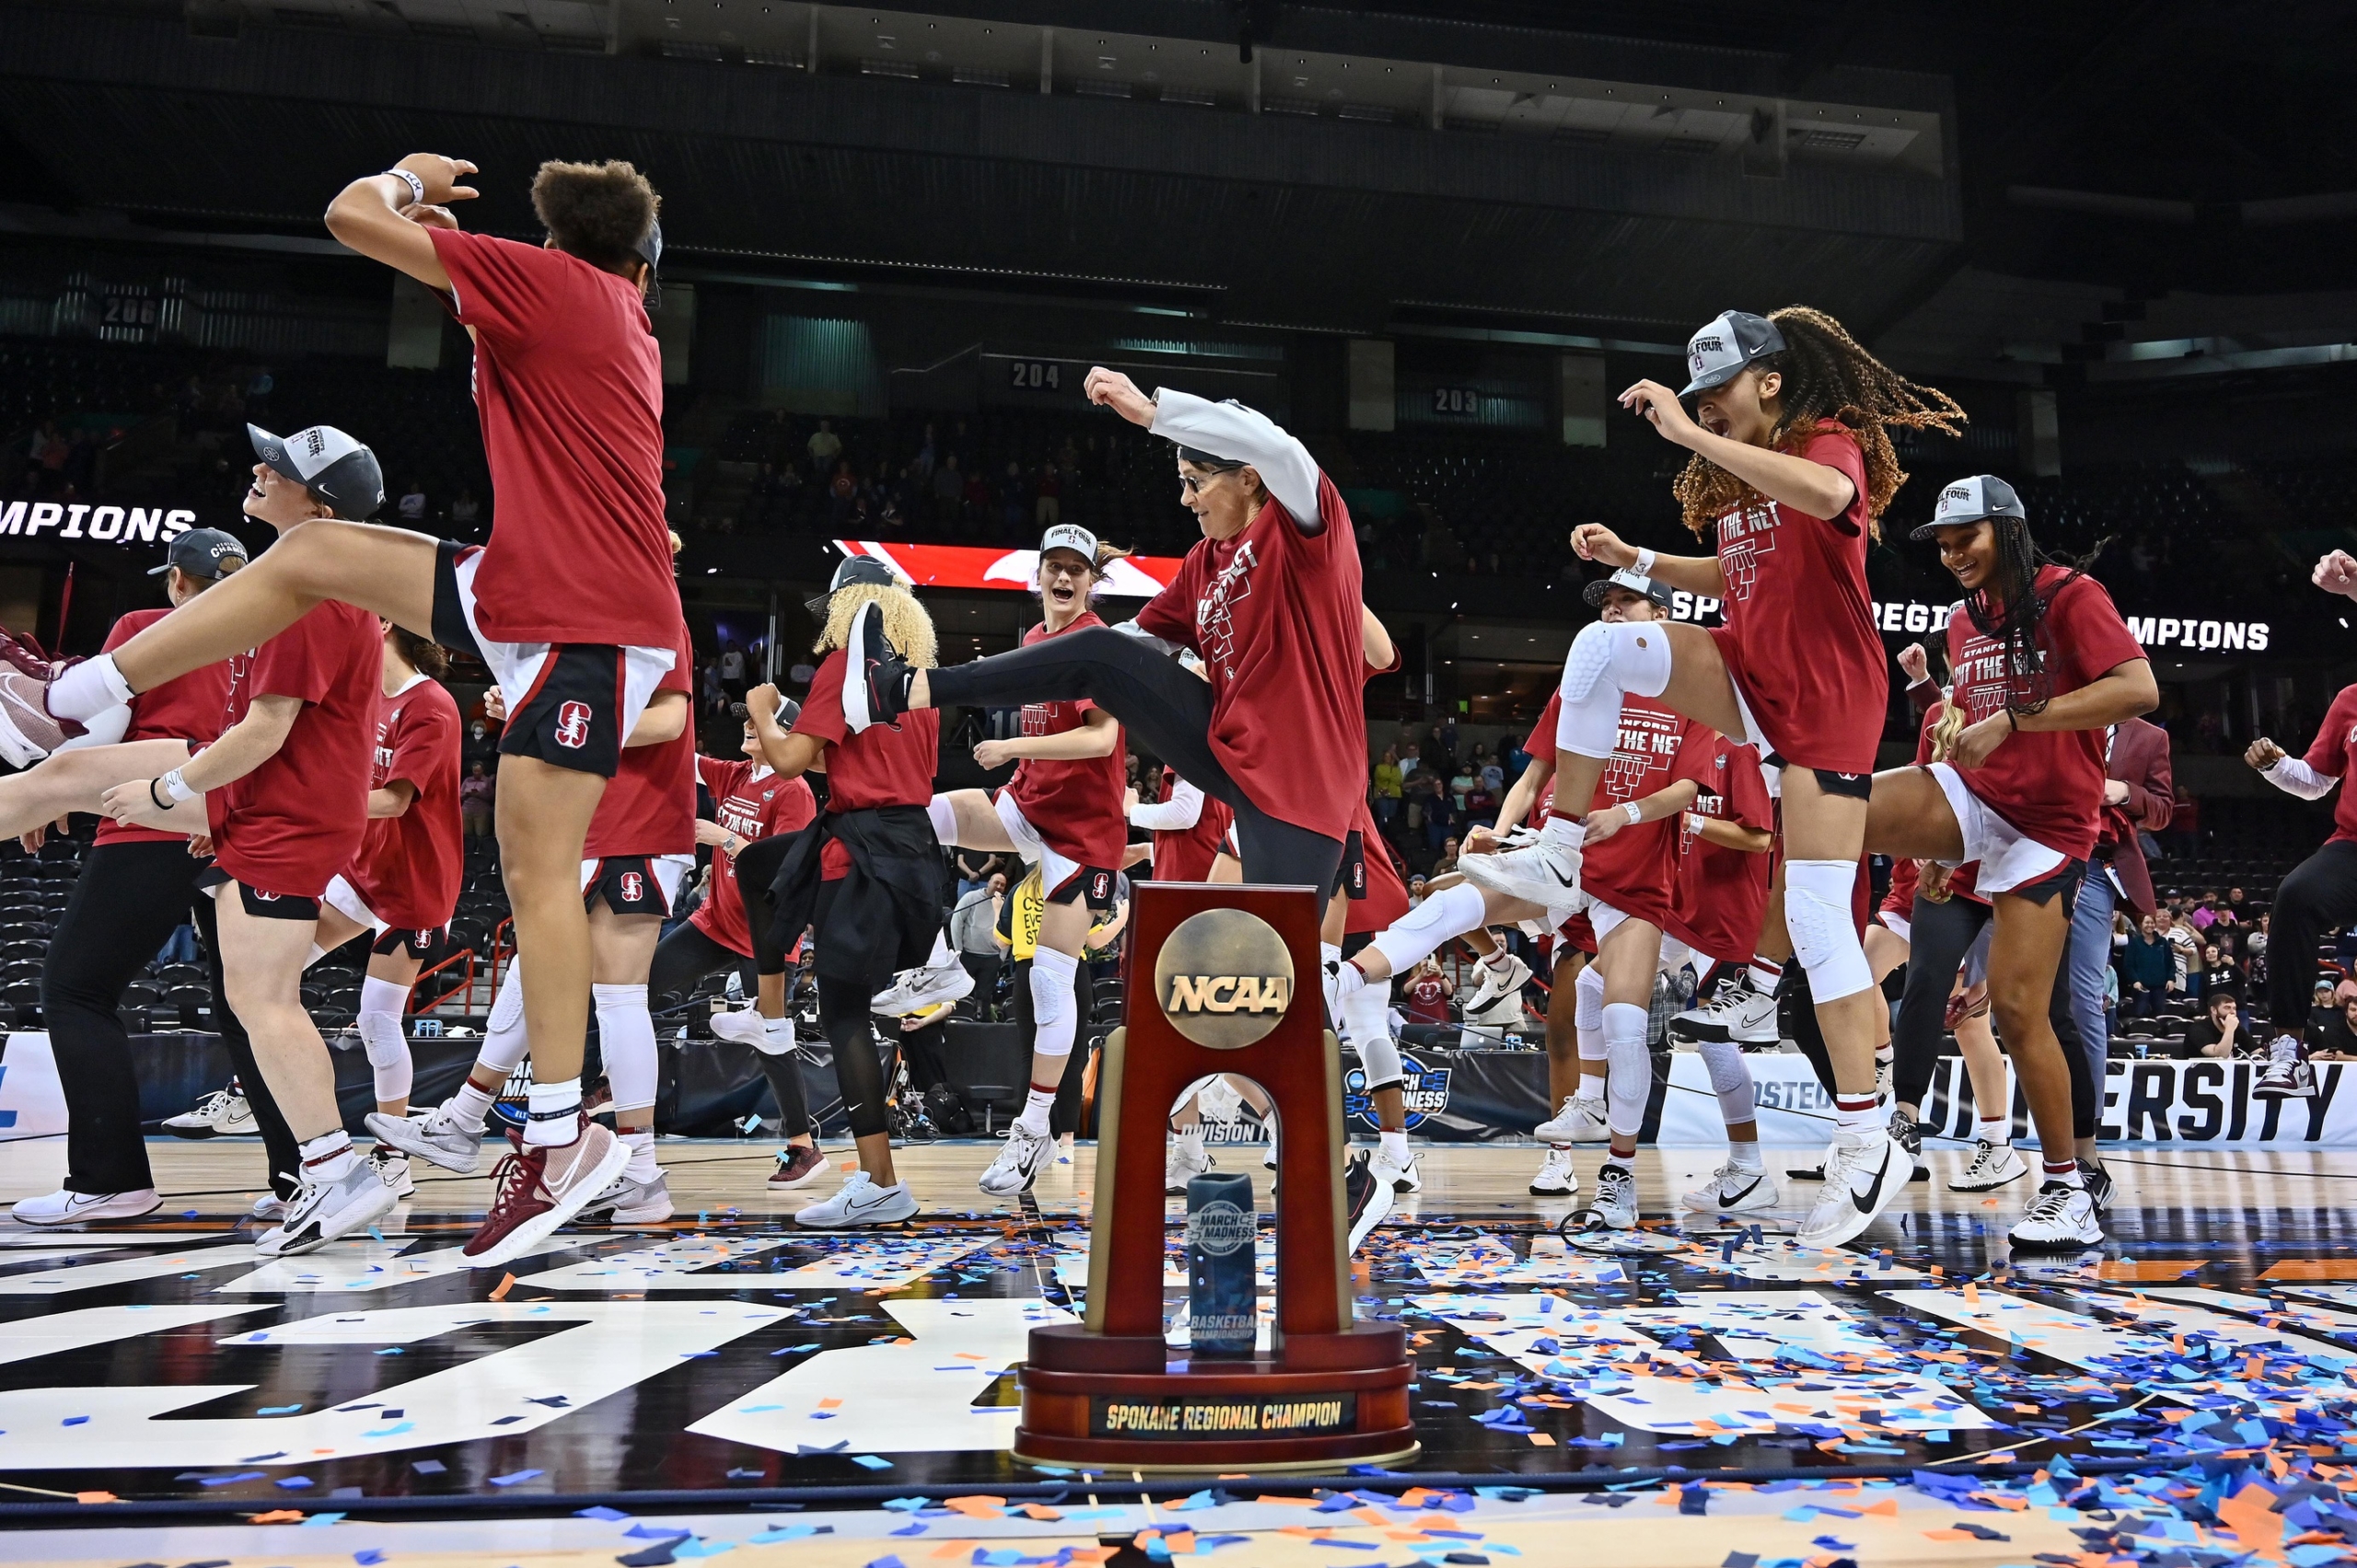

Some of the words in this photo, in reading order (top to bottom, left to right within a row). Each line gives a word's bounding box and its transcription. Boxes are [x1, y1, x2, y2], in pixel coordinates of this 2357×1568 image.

[105, 297, 156, 324] 206
[1696, 341, 1724, 354] FOUR
[1013, 363, 1059, 389] 204
[1436, 389, 1477, 412] 203
[1945, 490, 1969, 502] FOUR
[1723, 510, 1746, 542] THE
[1746, 500, 1782, 533] NET
[1051, 528, 1074, 539] FINAL
[1074, 530, 1092, 548] FOUR
[1975, 654, 2006, 681] THE
[1615, 729, 1649, 752] THE
[1696, 795, 1724, 815] NET
[741, 818, 764, 837] NET
[1168, 975, 1289, 1014] NCAA
[1200, 1214, 1238, 1226] MARCH
[1204, 1225, 1256, 1238] MADNESS
[1190, 1314, 1266, 1330] BASKETBALL
[1190, 1329, 1254, 1340] CHAMPIONSHIP
[1106, 1403, 1181, 1431] SPOKANE
[1181, 1404, 1259, 1432] REGIONAL
[1260, 1400, 1342, 1430] CHAMPION
